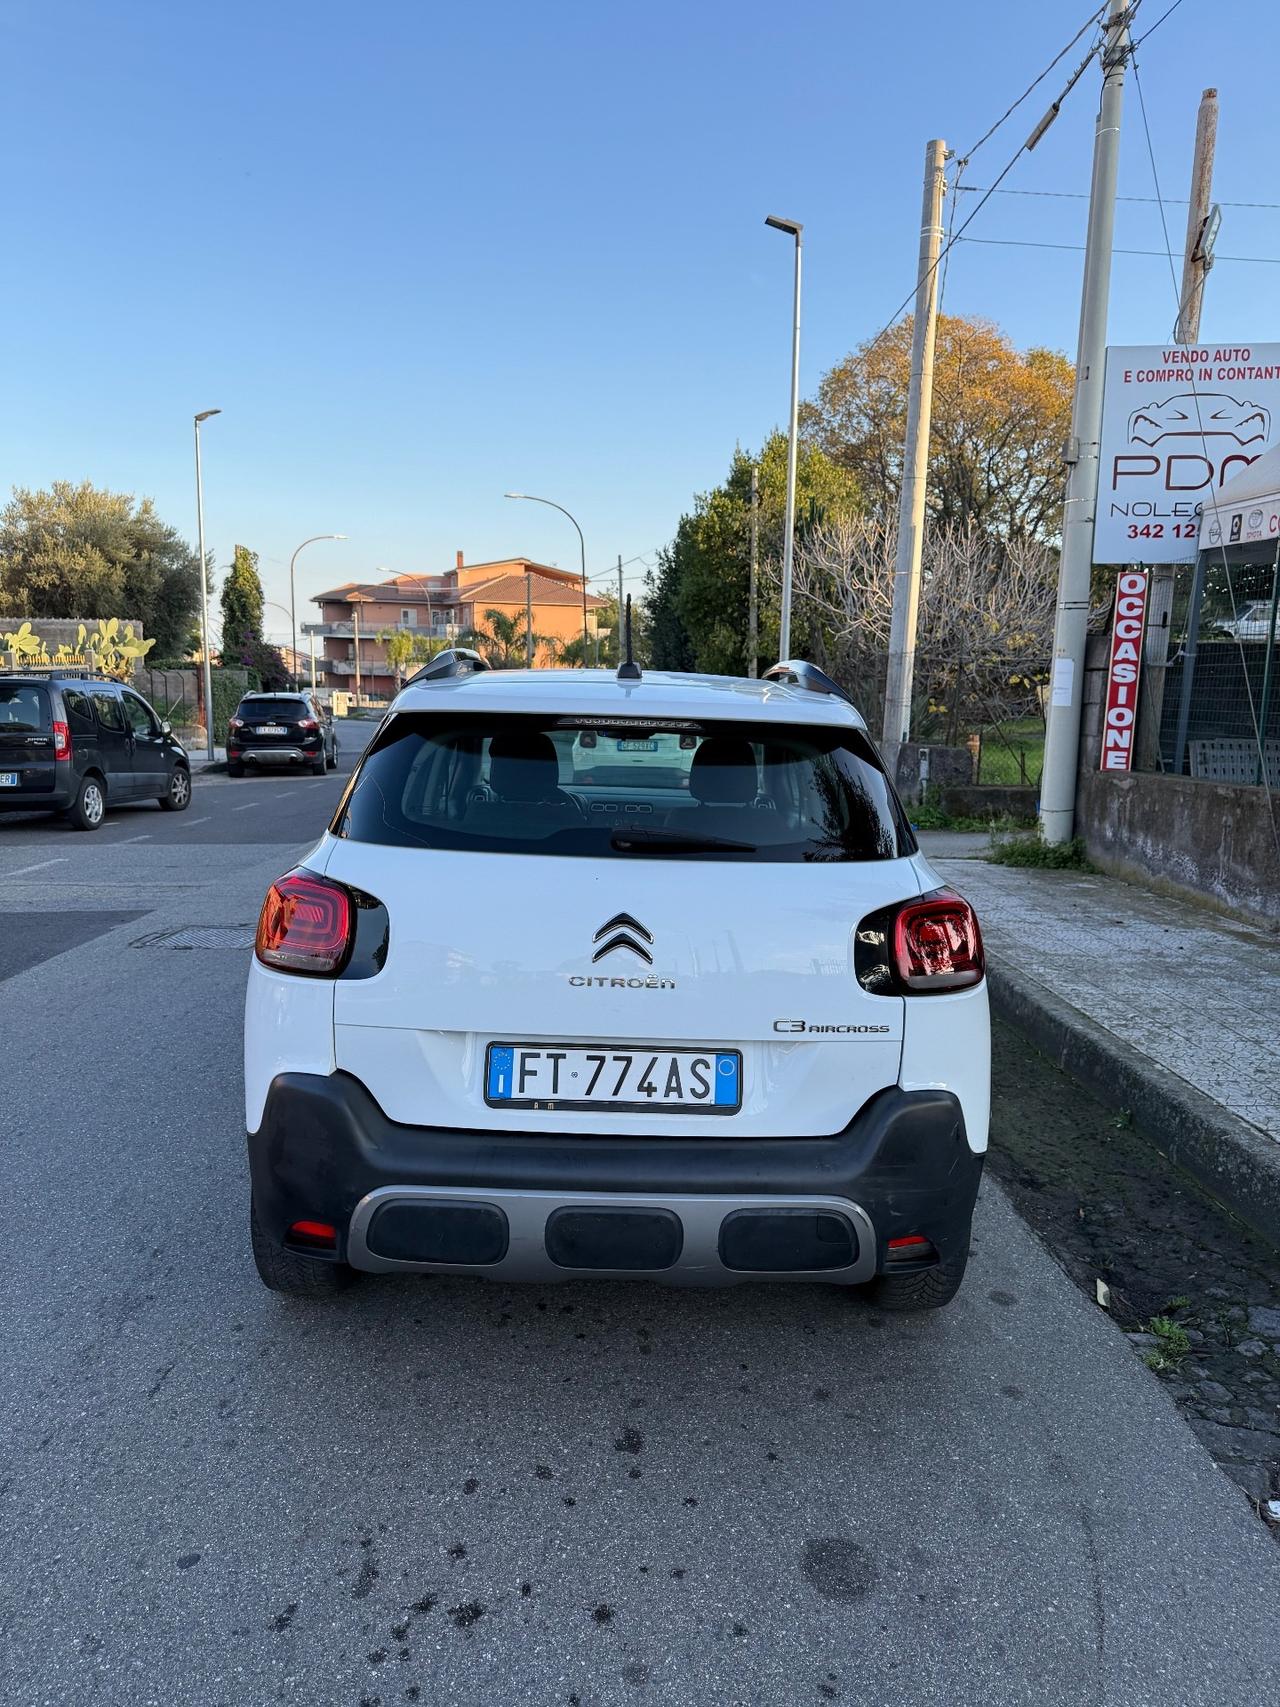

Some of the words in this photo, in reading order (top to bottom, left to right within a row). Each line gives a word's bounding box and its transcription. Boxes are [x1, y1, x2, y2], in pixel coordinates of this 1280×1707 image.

[1162, 350, 1209, 364] VENDO
[1213, 348, 1251, 363] AUTO
[1124, 370, 1132, 383] E
[1136, 368, 1194, 383] COMPRO
[1198, 368, 1213, 381] IN
[1127, 524, 1164, 539] 342
[1106, 574, 1146, 770] OCCASIONE
[773, 1018, 806, 1033] C3
[808, 1024, 890, 1034] AIRCROSS
[519, 1052, 567, 1095] FT
[584, 1055, 712, 1099] 774AS
